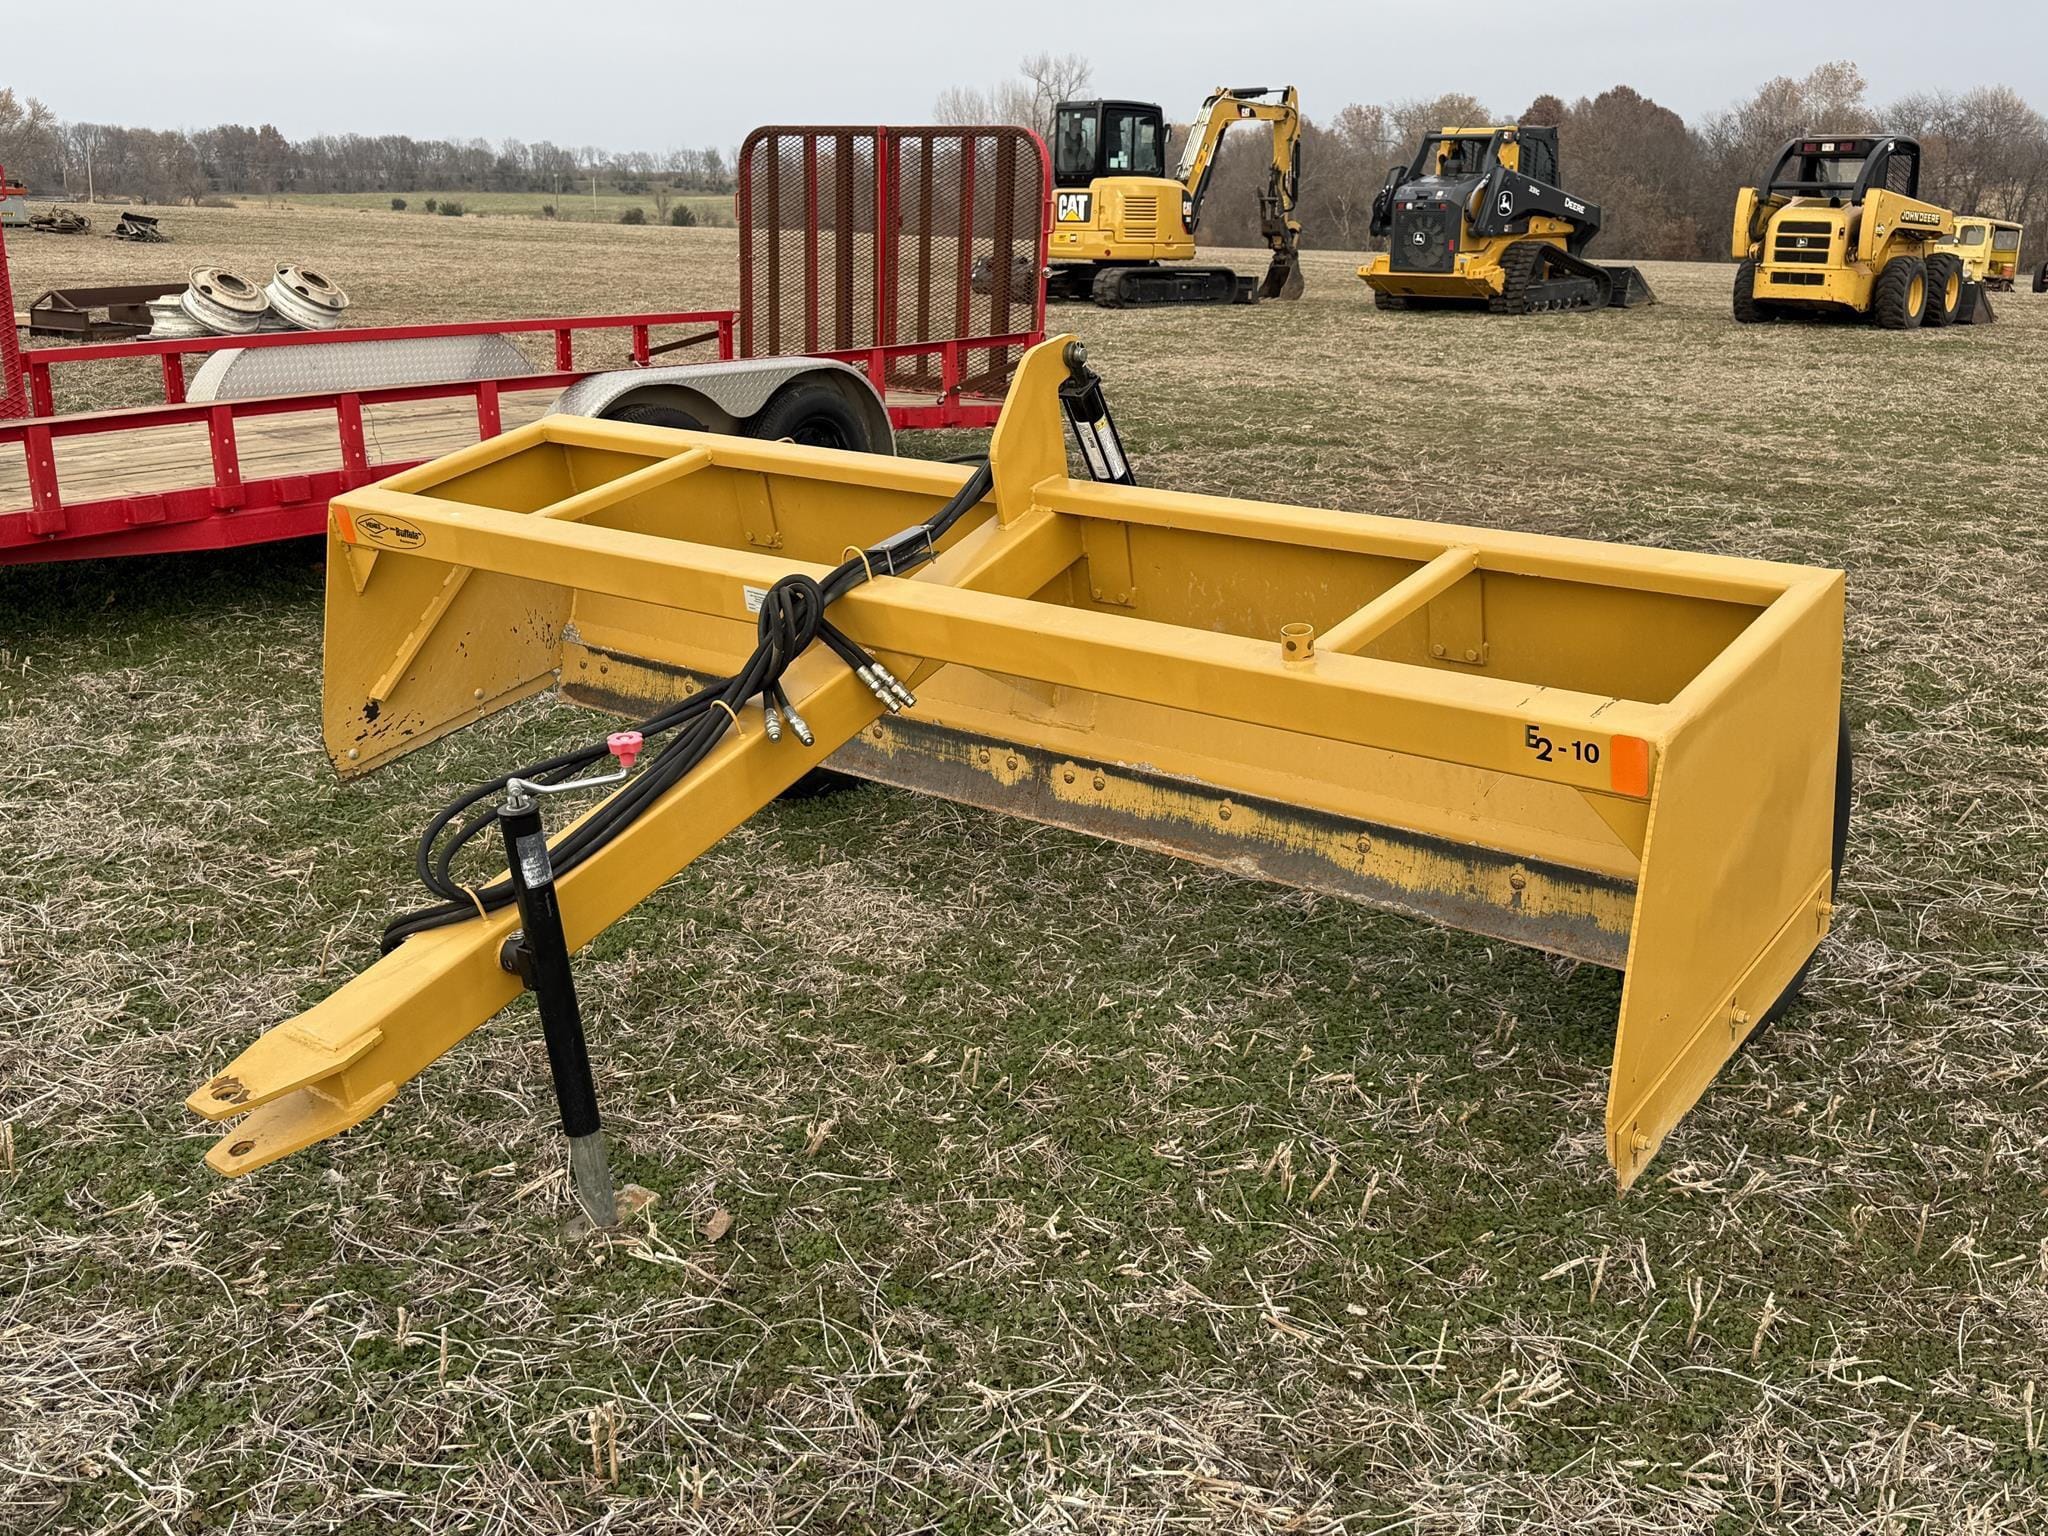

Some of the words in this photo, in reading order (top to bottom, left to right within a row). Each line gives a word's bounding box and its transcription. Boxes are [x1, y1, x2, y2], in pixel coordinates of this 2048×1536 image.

[1058, 194, 1089, 222] CAT
[1564, 197, 1586, 215] DEERE
[1901, 210, 1919, 222] JOHN
[1919, 212, 1941, 224] DEERE
